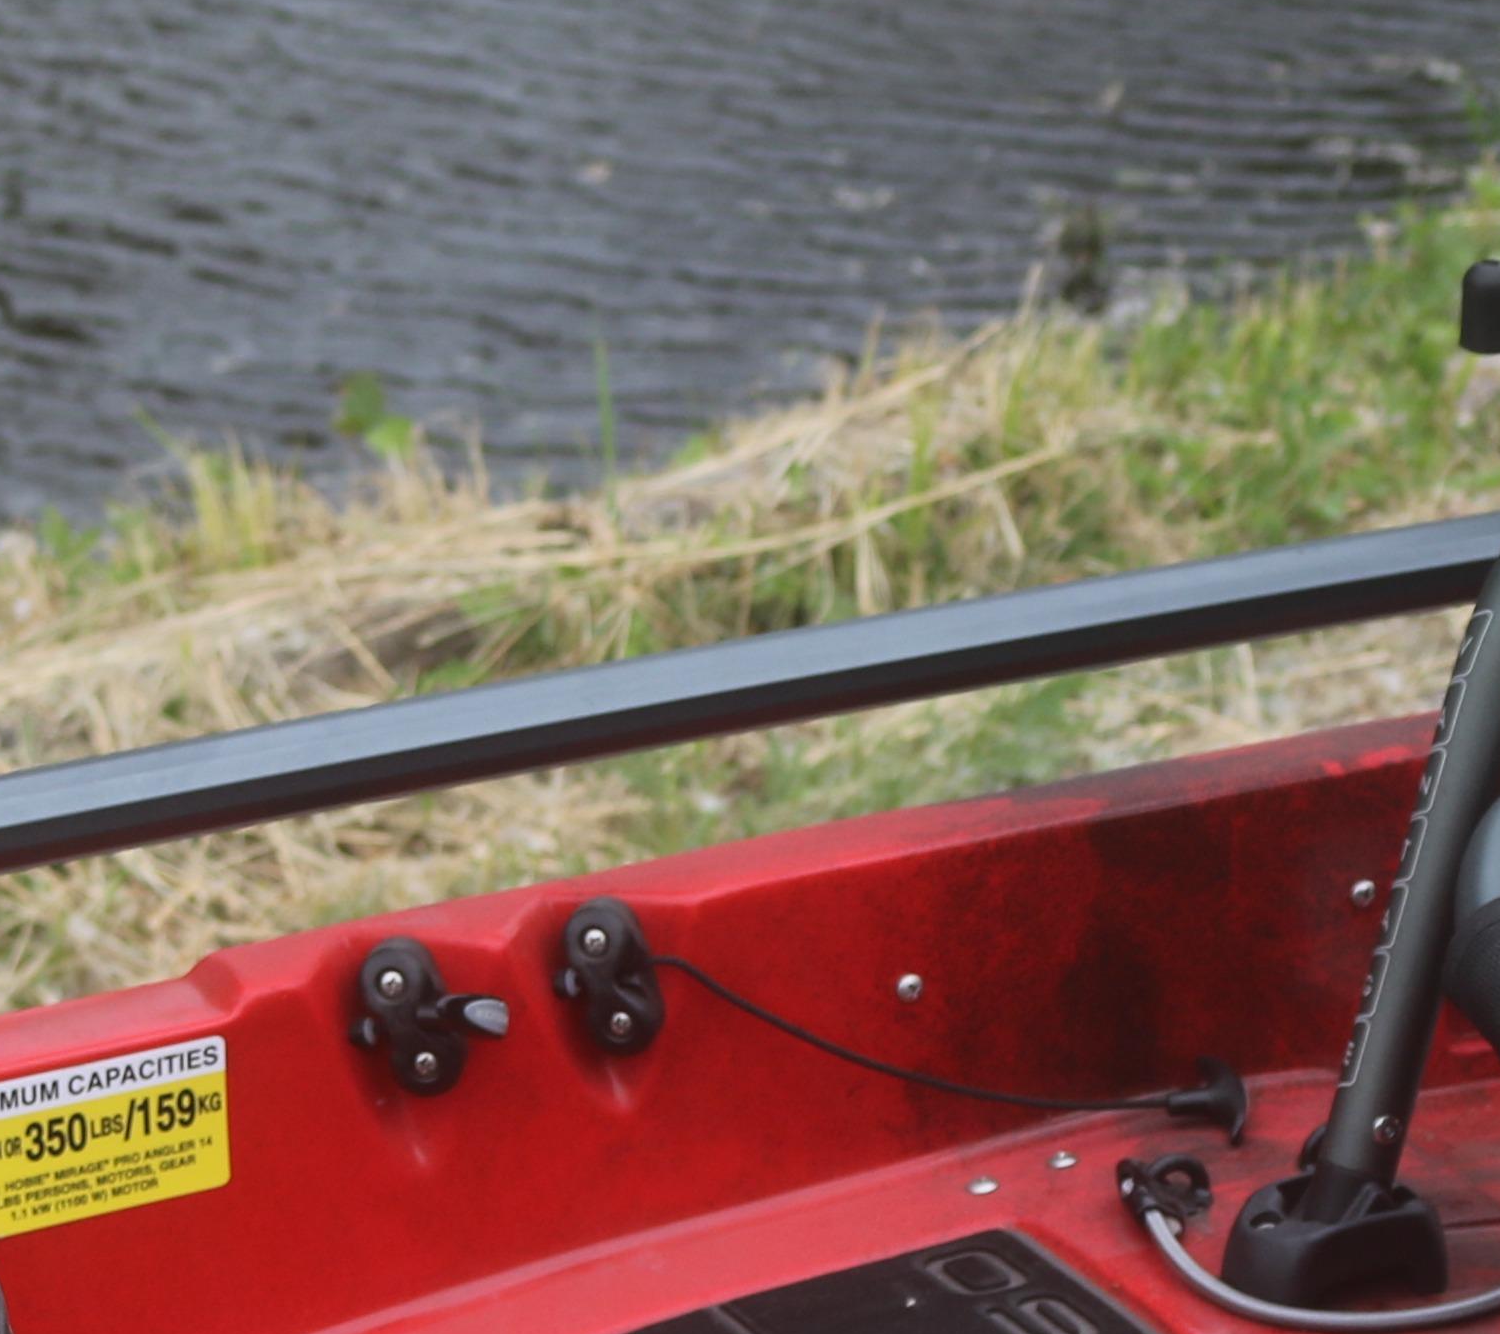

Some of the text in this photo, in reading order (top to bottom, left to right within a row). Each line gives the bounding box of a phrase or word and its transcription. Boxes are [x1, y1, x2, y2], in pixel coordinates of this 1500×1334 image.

[67, 1045, 219, 1096] CAPACITIES
[4, 1136, 22, 1158] OR
[113, 1152, 141, 1168] PRO
[144, 1139, 196, 1160] ANGLER
[158, 1154, 197, 1172] GEAR
[111, 1177, 160, 1198] MOTOR
